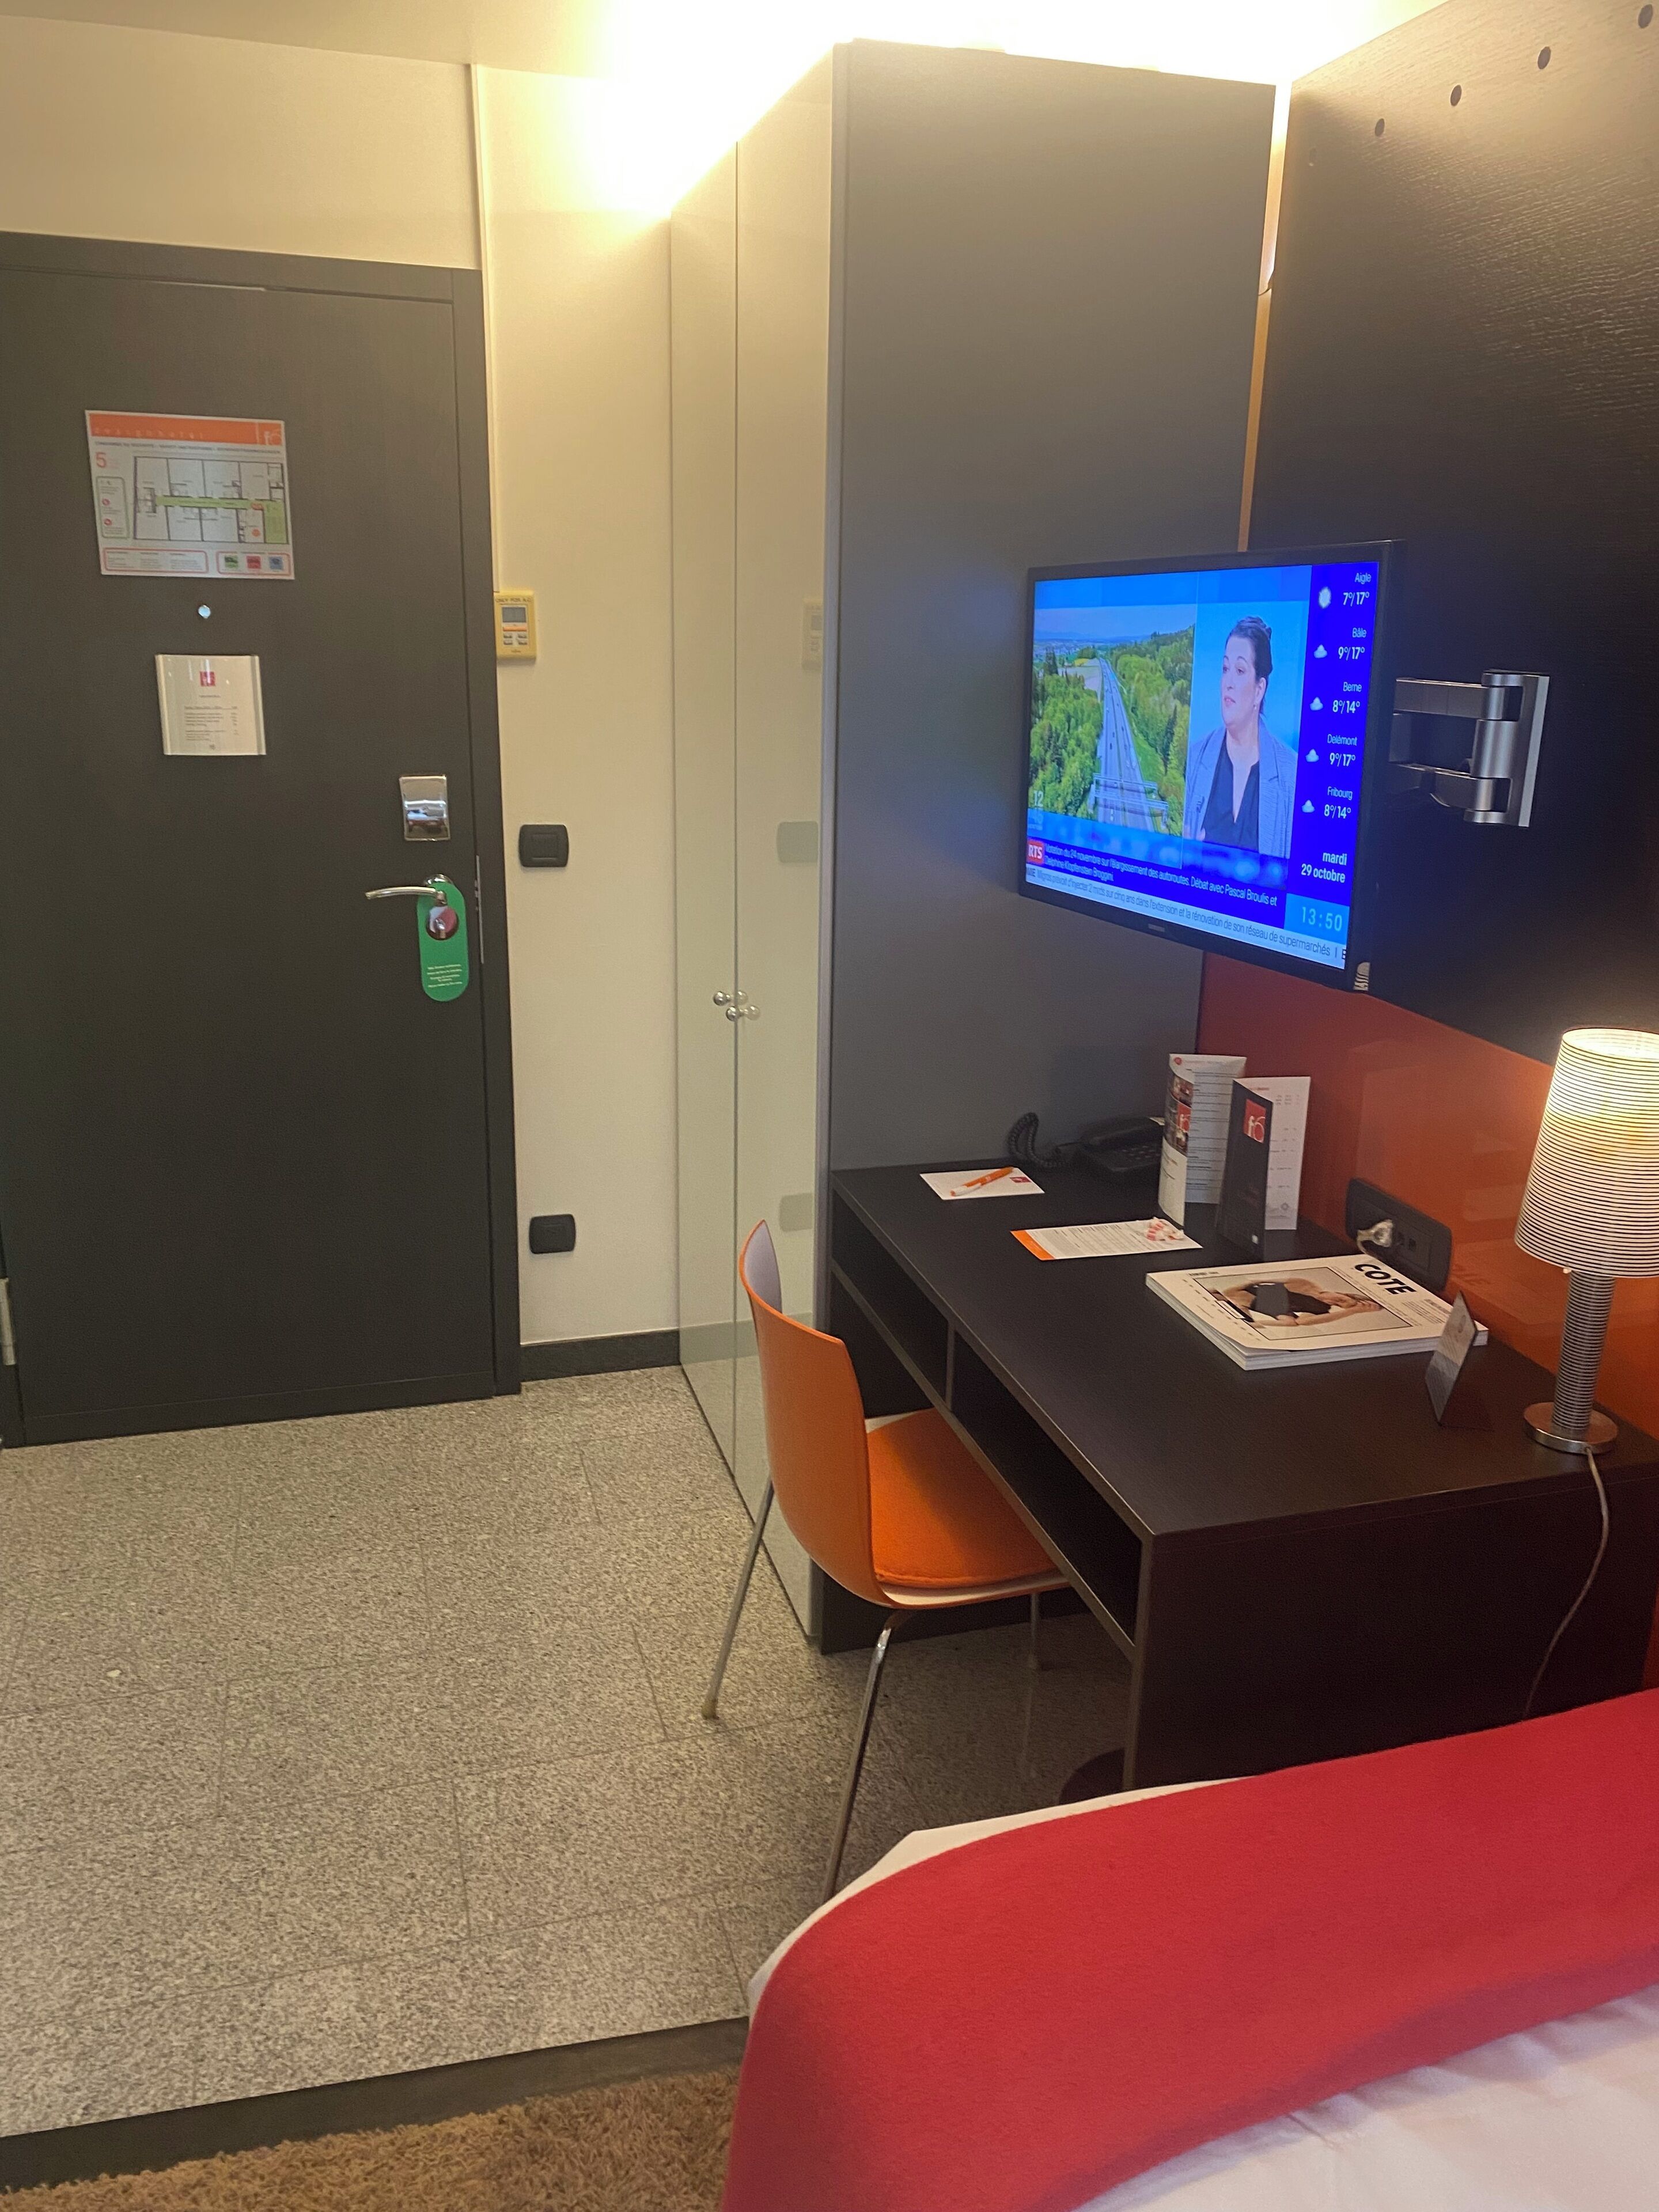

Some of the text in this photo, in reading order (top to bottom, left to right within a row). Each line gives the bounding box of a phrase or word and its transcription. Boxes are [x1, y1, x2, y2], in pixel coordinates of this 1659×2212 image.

[96, 452, 106, 468] 5
[1355, 573, 1372, 585] Aigle
[1343, 591, 1370, 607] 7°/17°
[1352, 627, 1367, 638] Bâle
[1338, 646, 1365, 661] 9°/17°
[1343, 681, 1362, 692] Berne
[1332, 700, 1361, 714] 8°/14°
[1327, 734, 1357, 746] Delémont
[1330, 752, 1356, 767] 9°/17°
[1327, 786, 1353, 801] Fribourg
[1324, 804, 1351, 819] 8°/14°
[1028, 844, 1043, 859] RTS
[1323, 852, 1347, 866] mardi
[1301, 863, 1346, 883] 29 octobre
[1148, 868, 1158, 879] des
[1159, 871, 1190, 887] autoroutes.
[1191, 876, 1209, 890] Débat
[1209, 882, 1225, 894] avec
[1225, 884, 1245, 899] Pascal
[1247, 889, 1269, 905] Broulis
[1270, 896, 1278, 907] et
[1126, 895, 1135, 904] ans
[1136, 896, 1149, 908] dans
[1149, 899, 1178, 915] l'extension
[1179, 907, 1185, 917] et
[1185, 908, 1191, 919] la
[1192, 911, 1223, 927] rénovation
[1224, 919, 1232, 930] de
[1233, 923, 1245, 933] son
[1245, 925, 1268, 940] réseau
[1269, 931, 1278, 942] de
[1279, 934, 1331, 956] supermarchés
[1302, 906, 1343, 931] 13:50
[1355, 1264, 1417, 1295] COTE
